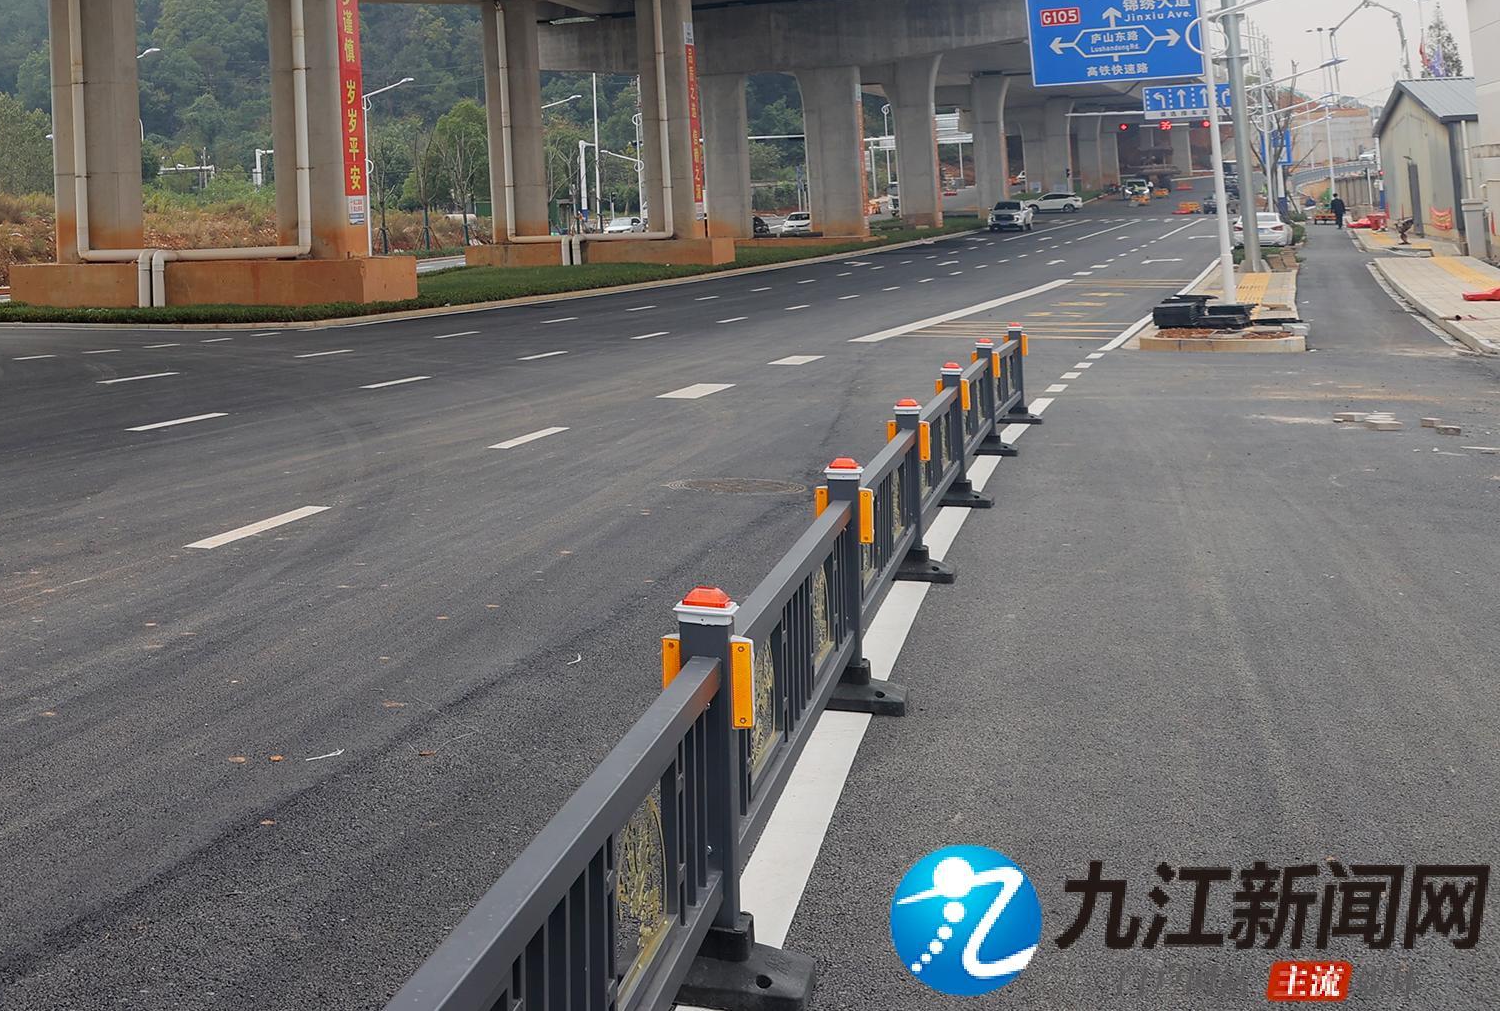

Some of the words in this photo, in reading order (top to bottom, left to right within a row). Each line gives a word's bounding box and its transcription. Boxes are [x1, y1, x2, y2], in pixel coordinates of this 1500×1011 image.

[1043, 10, 1077, 24] G105
[1124, 13, 1164, 22] Jinxiu
[1167, 10, 1192, 19] Ave.
[1091, 30, 1139, 44] 庐山东路
[1087, 62, 1148, 77] 高铁快速路
[345, 79, 361, 190] 岁岁平安
